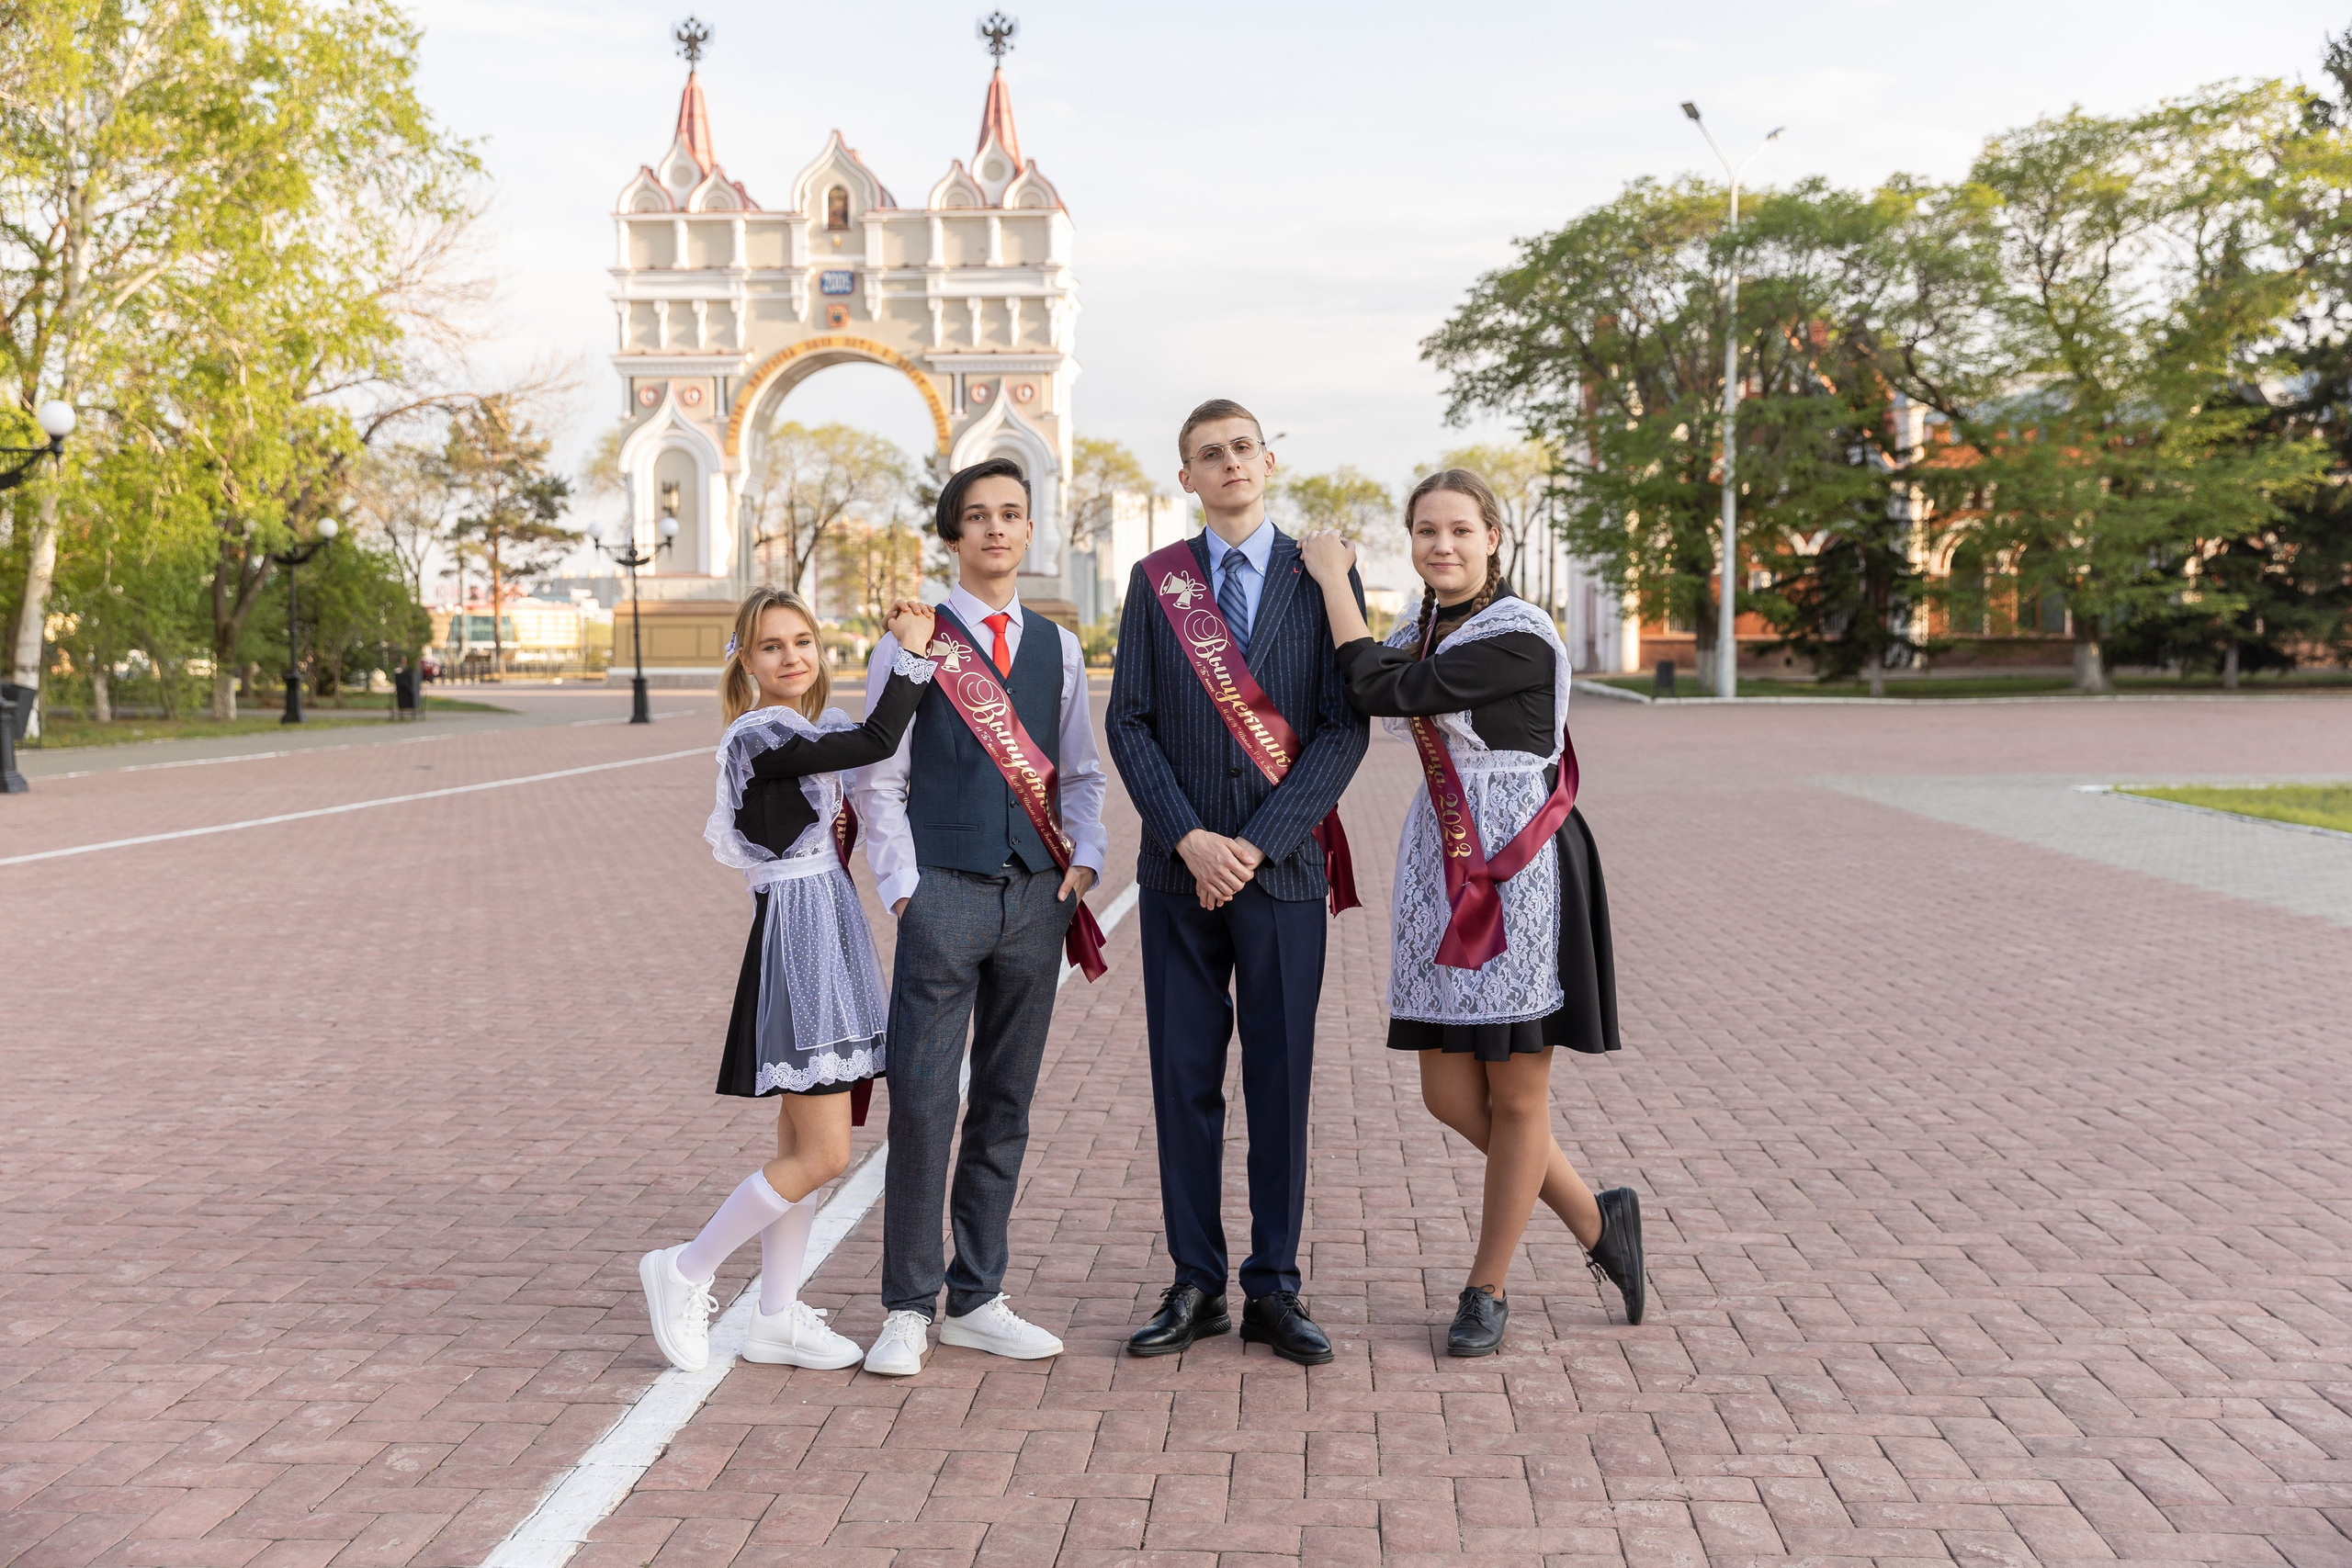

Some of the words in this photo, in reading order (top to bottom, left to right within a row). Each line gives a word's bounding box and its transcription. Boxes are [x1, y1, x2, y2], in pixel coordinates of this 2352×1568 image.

[957, 671, 1059, 834] Выпускн
[1183, 609, 1292, 768] Выпускник
[1439, 793, 1472, 858] 2023
